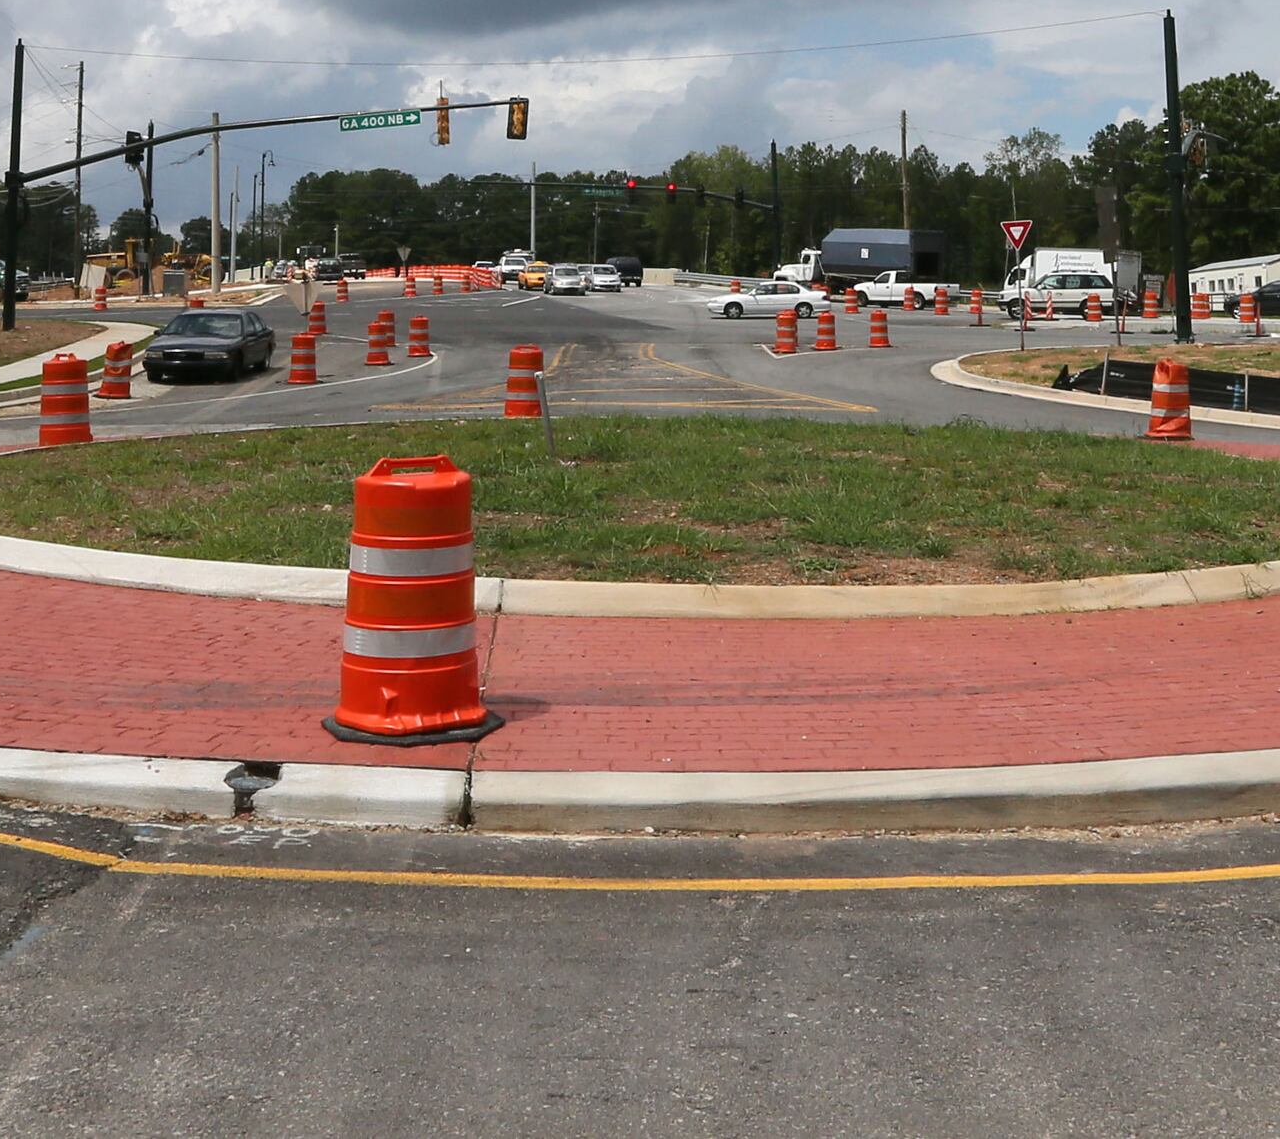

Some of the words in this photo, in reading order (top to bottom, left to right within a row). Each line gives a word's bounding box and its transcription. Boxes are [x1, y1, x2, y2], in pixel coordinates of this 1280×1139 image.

[342, 119, 359, 129] GA
[361, 117, 385, 127] 400
[388, 114, 404, 125] NB
